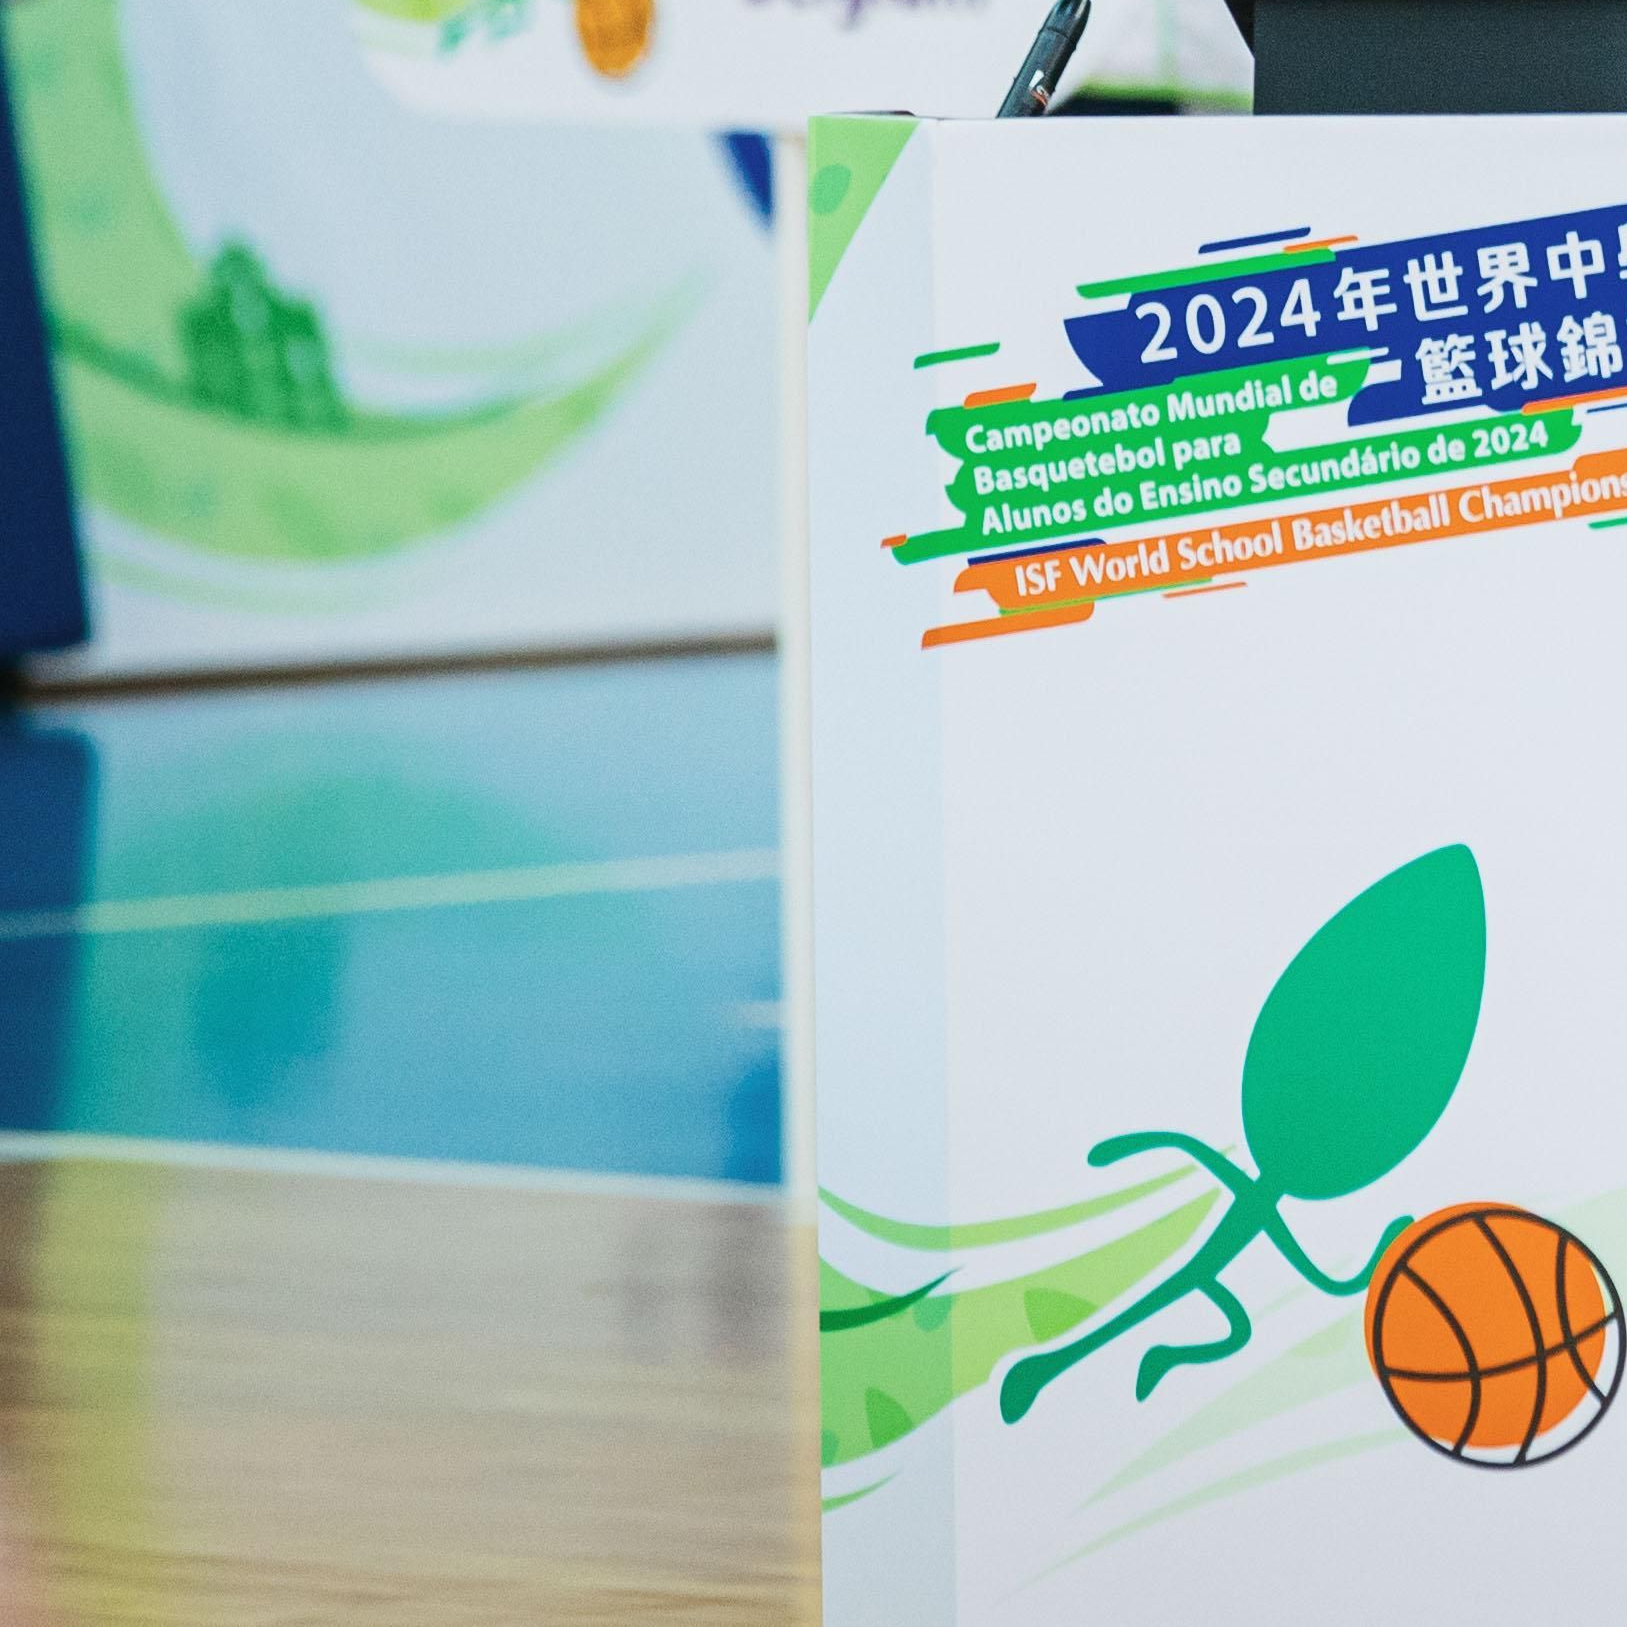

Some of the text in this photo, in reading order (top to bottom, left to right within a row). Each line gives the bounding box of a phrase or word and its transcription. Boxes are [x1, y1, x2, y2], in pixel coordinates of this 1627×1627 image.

[965, 371, 1338, 453] Campeonato Mundial de
[973, 432, 1241, 495] Basquetebol para
[981, 419, 1549, 536] Alunos do Ensino Secundário de 2024
[1015, 560, 1062, 596] ISF
[1068, 539, 1169, 587] World
[1178, 522, 1284, 571] School
[1291, 491, 1451, 549] Basketball
